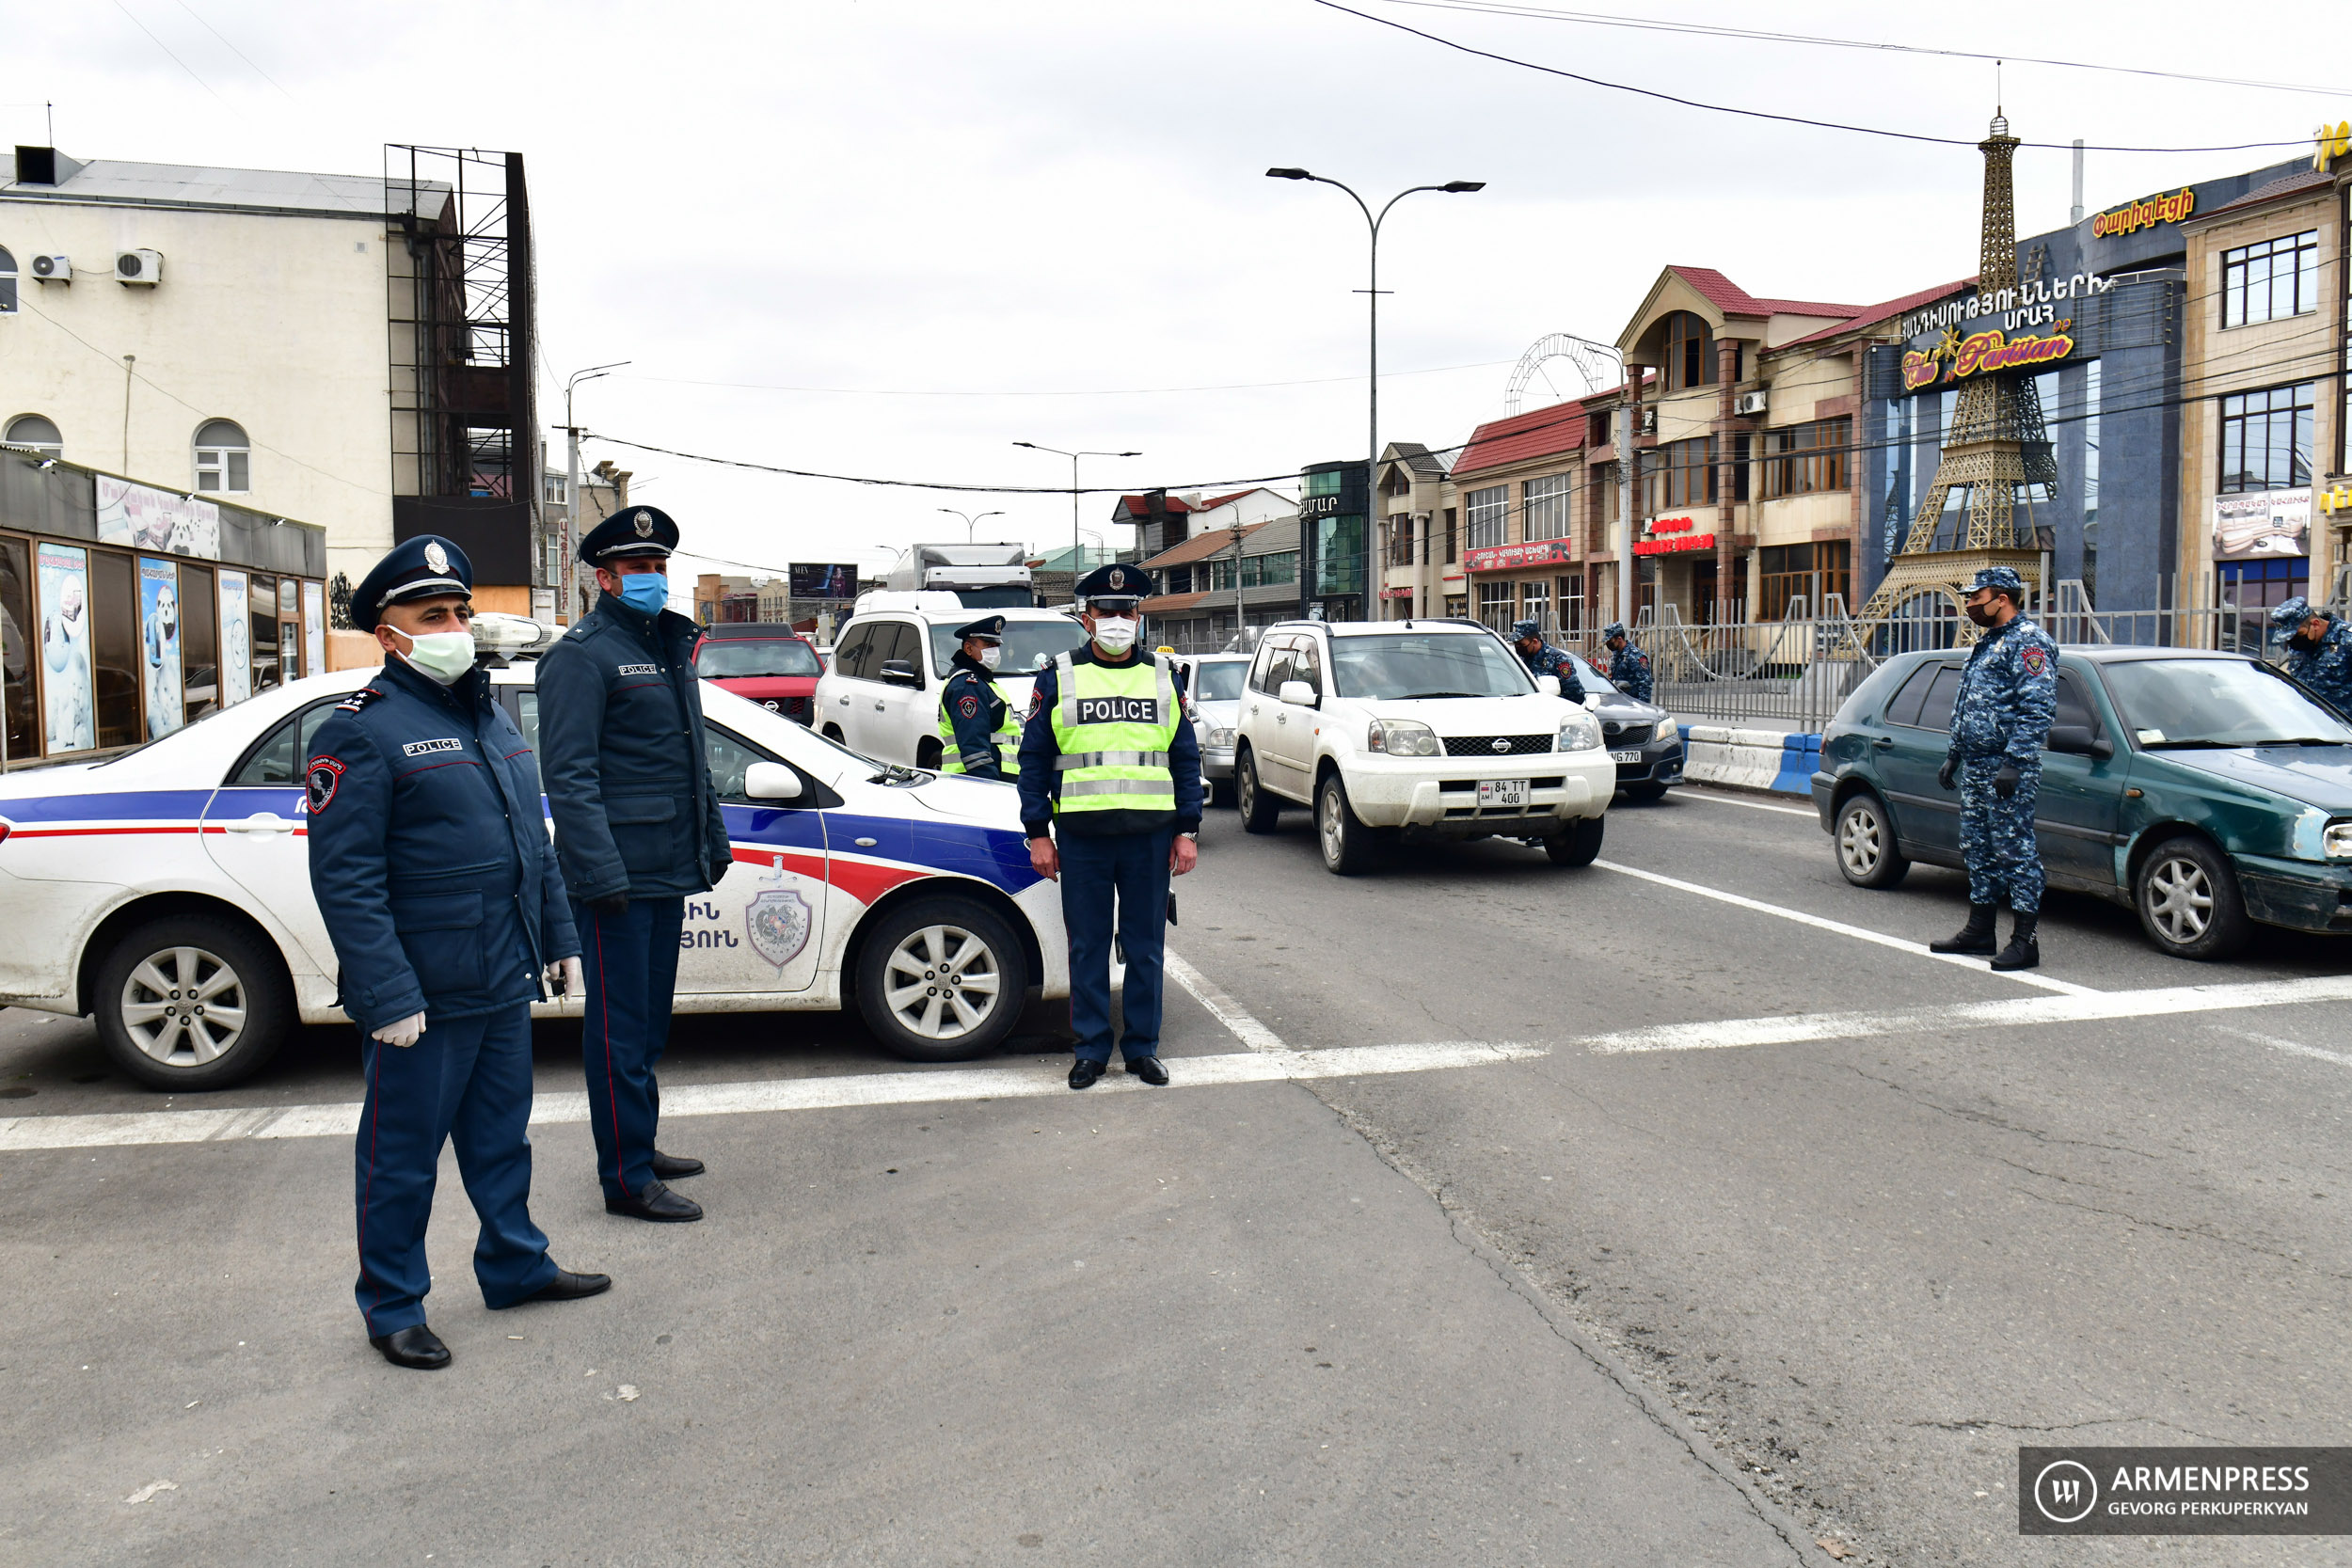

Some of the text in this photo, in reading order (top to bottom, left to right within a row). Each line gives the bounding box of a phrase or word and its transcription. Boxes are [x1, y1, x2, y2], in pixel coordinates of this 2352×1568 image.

[2092, 187, 2194, 238] Փարիզեցի
[2004, 304, 2055, 331] ՍՐԱՀ
[621, 665, 656, 674] POLICE
[1083, 701, 1152, 721] POLICE
[406, 739, 460, 754] POLICE
[1625, 752, 1639, 761] 770
[1495, 781, 1526, 792] 84 TT
[1502, 793, 1520, 803] 400
[683, 902, 721, 921] ԻՆ
